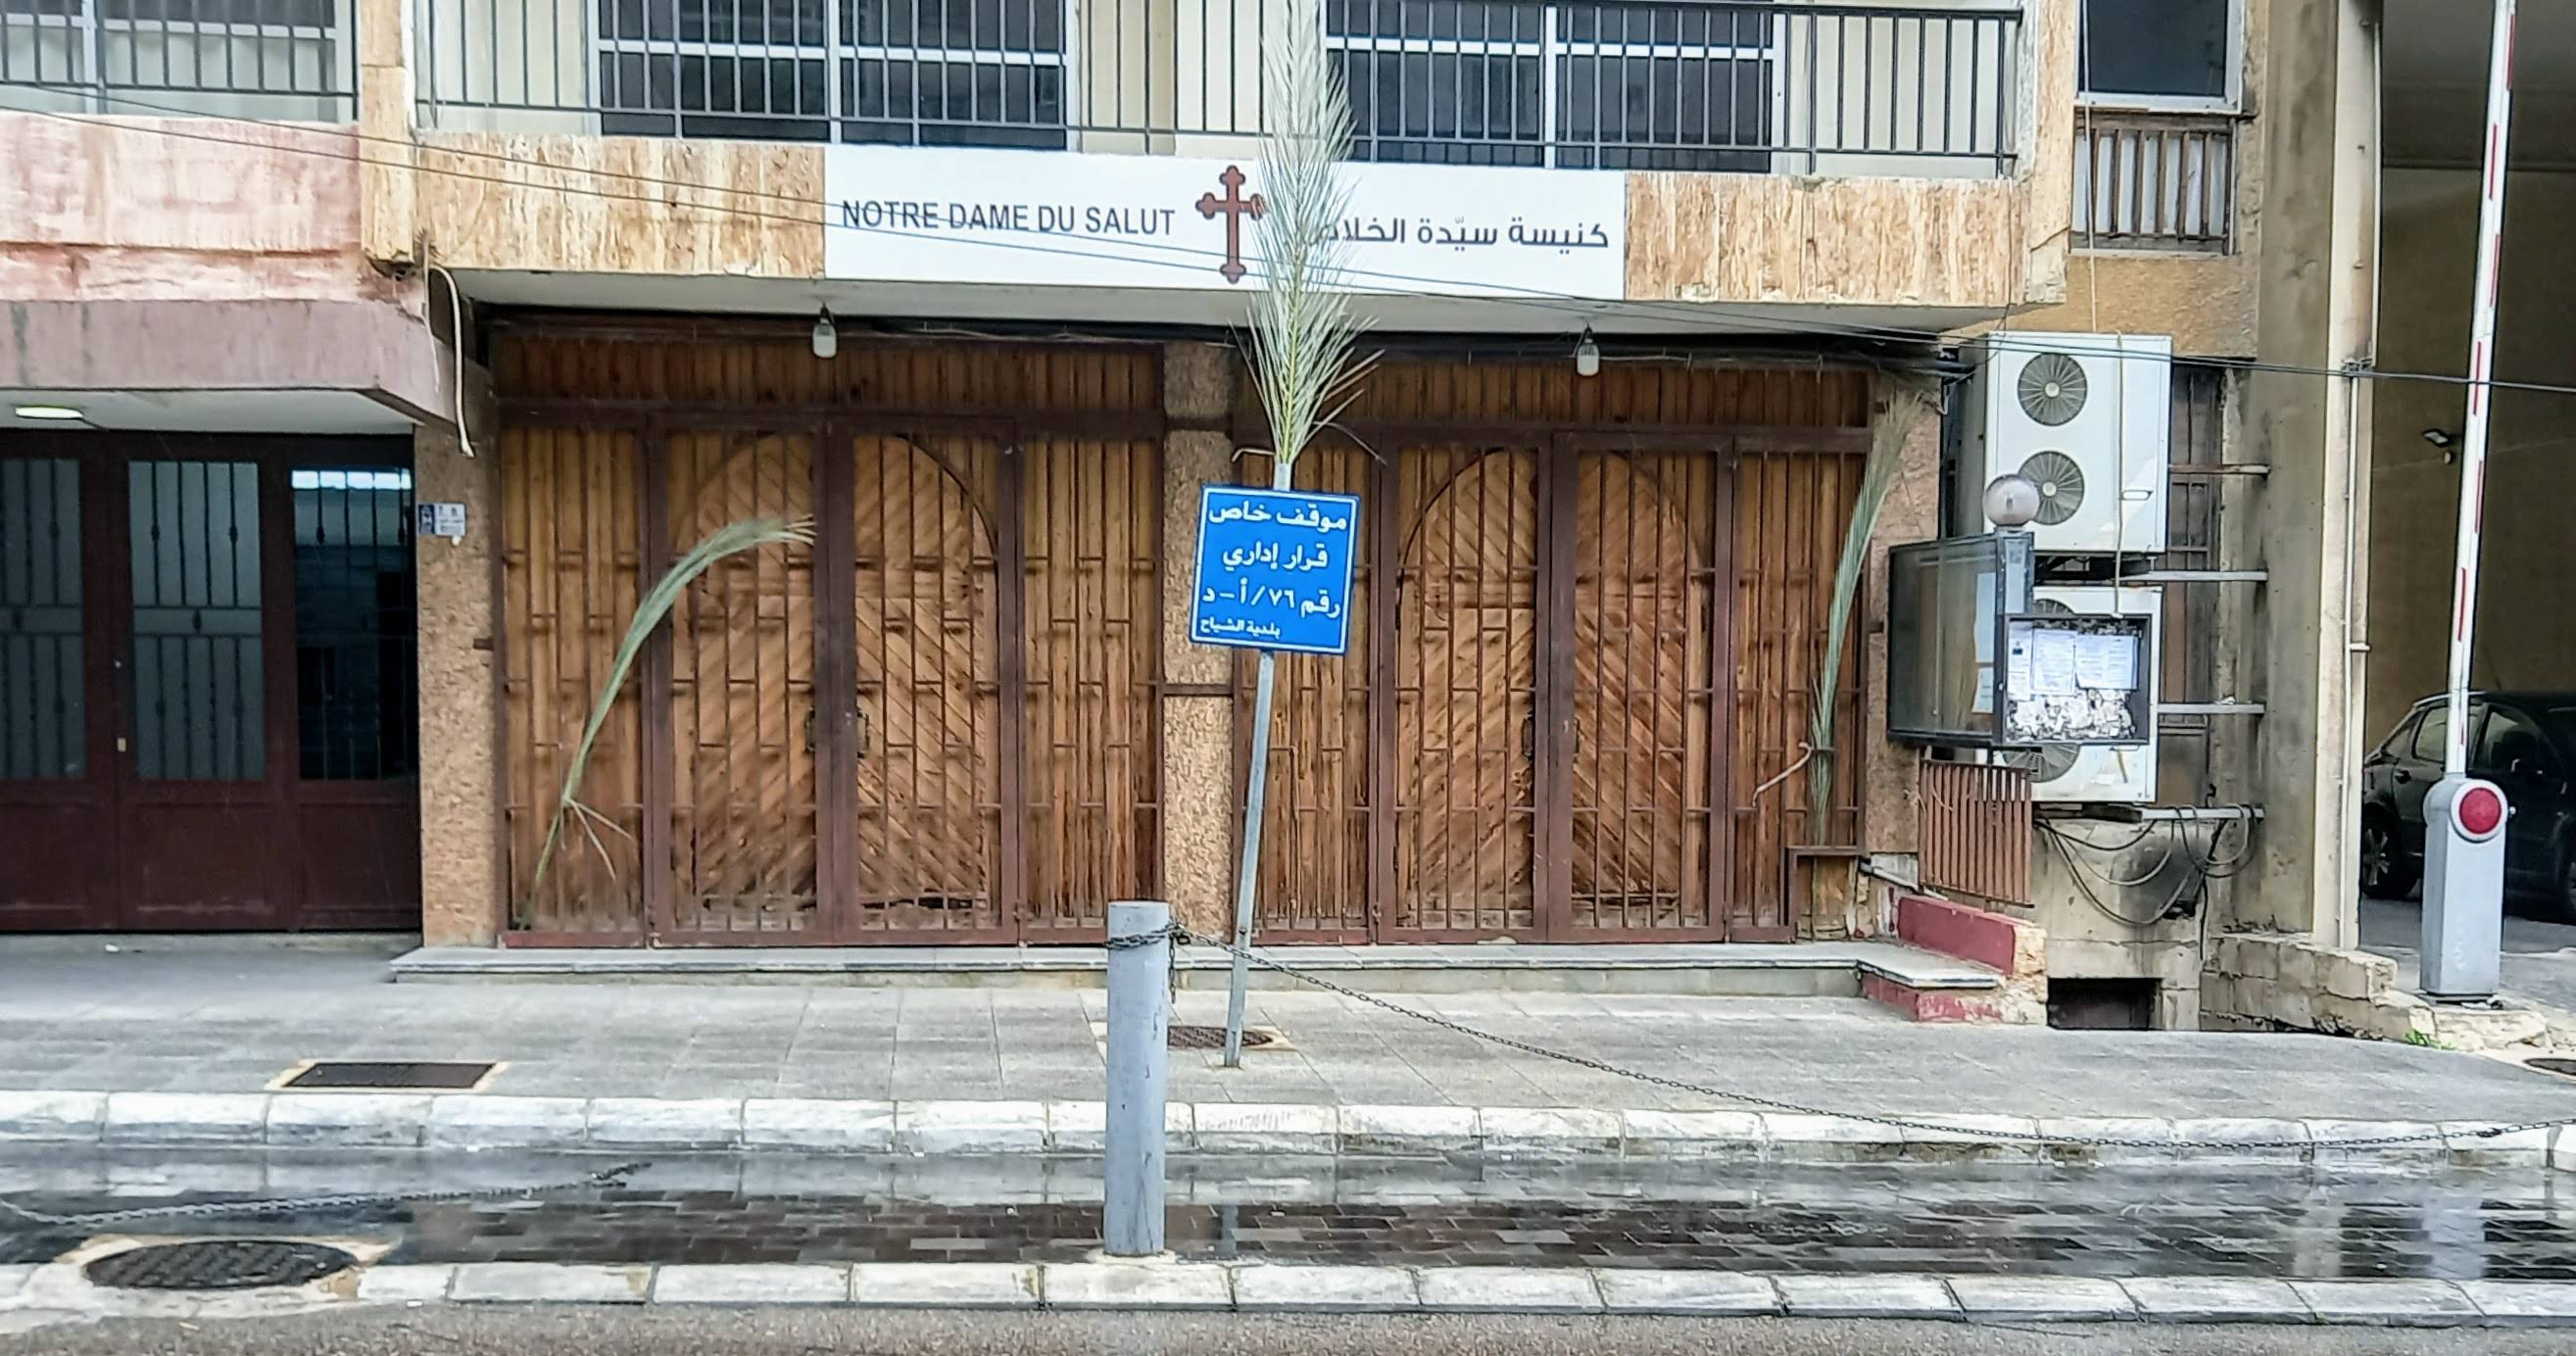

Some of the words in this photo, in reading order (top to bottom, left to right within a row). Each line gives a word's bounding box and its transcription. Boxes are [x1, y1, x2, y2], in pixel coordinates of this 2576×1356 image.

[842, 200, 940, 229] NOTRE
[948, 202, 1029, 231] DAME
[1038, 205, 1076, 232] DU
[1085, 206, 1176, 236] SALUT
[1508, 216, 1609, 255] كنيسة
[1208, 500, 1272, 523] خاص
[1276, 502, 1347, 533] موقف
[1223, 540, 1279, 571] إداري
[1282, 543, 1329, 570] قرار
[1300, 589, 1340, 618] رقم
[1200, 616, 1244, 634] الشياح
[1245, 619, 1281, 640] بلدية
